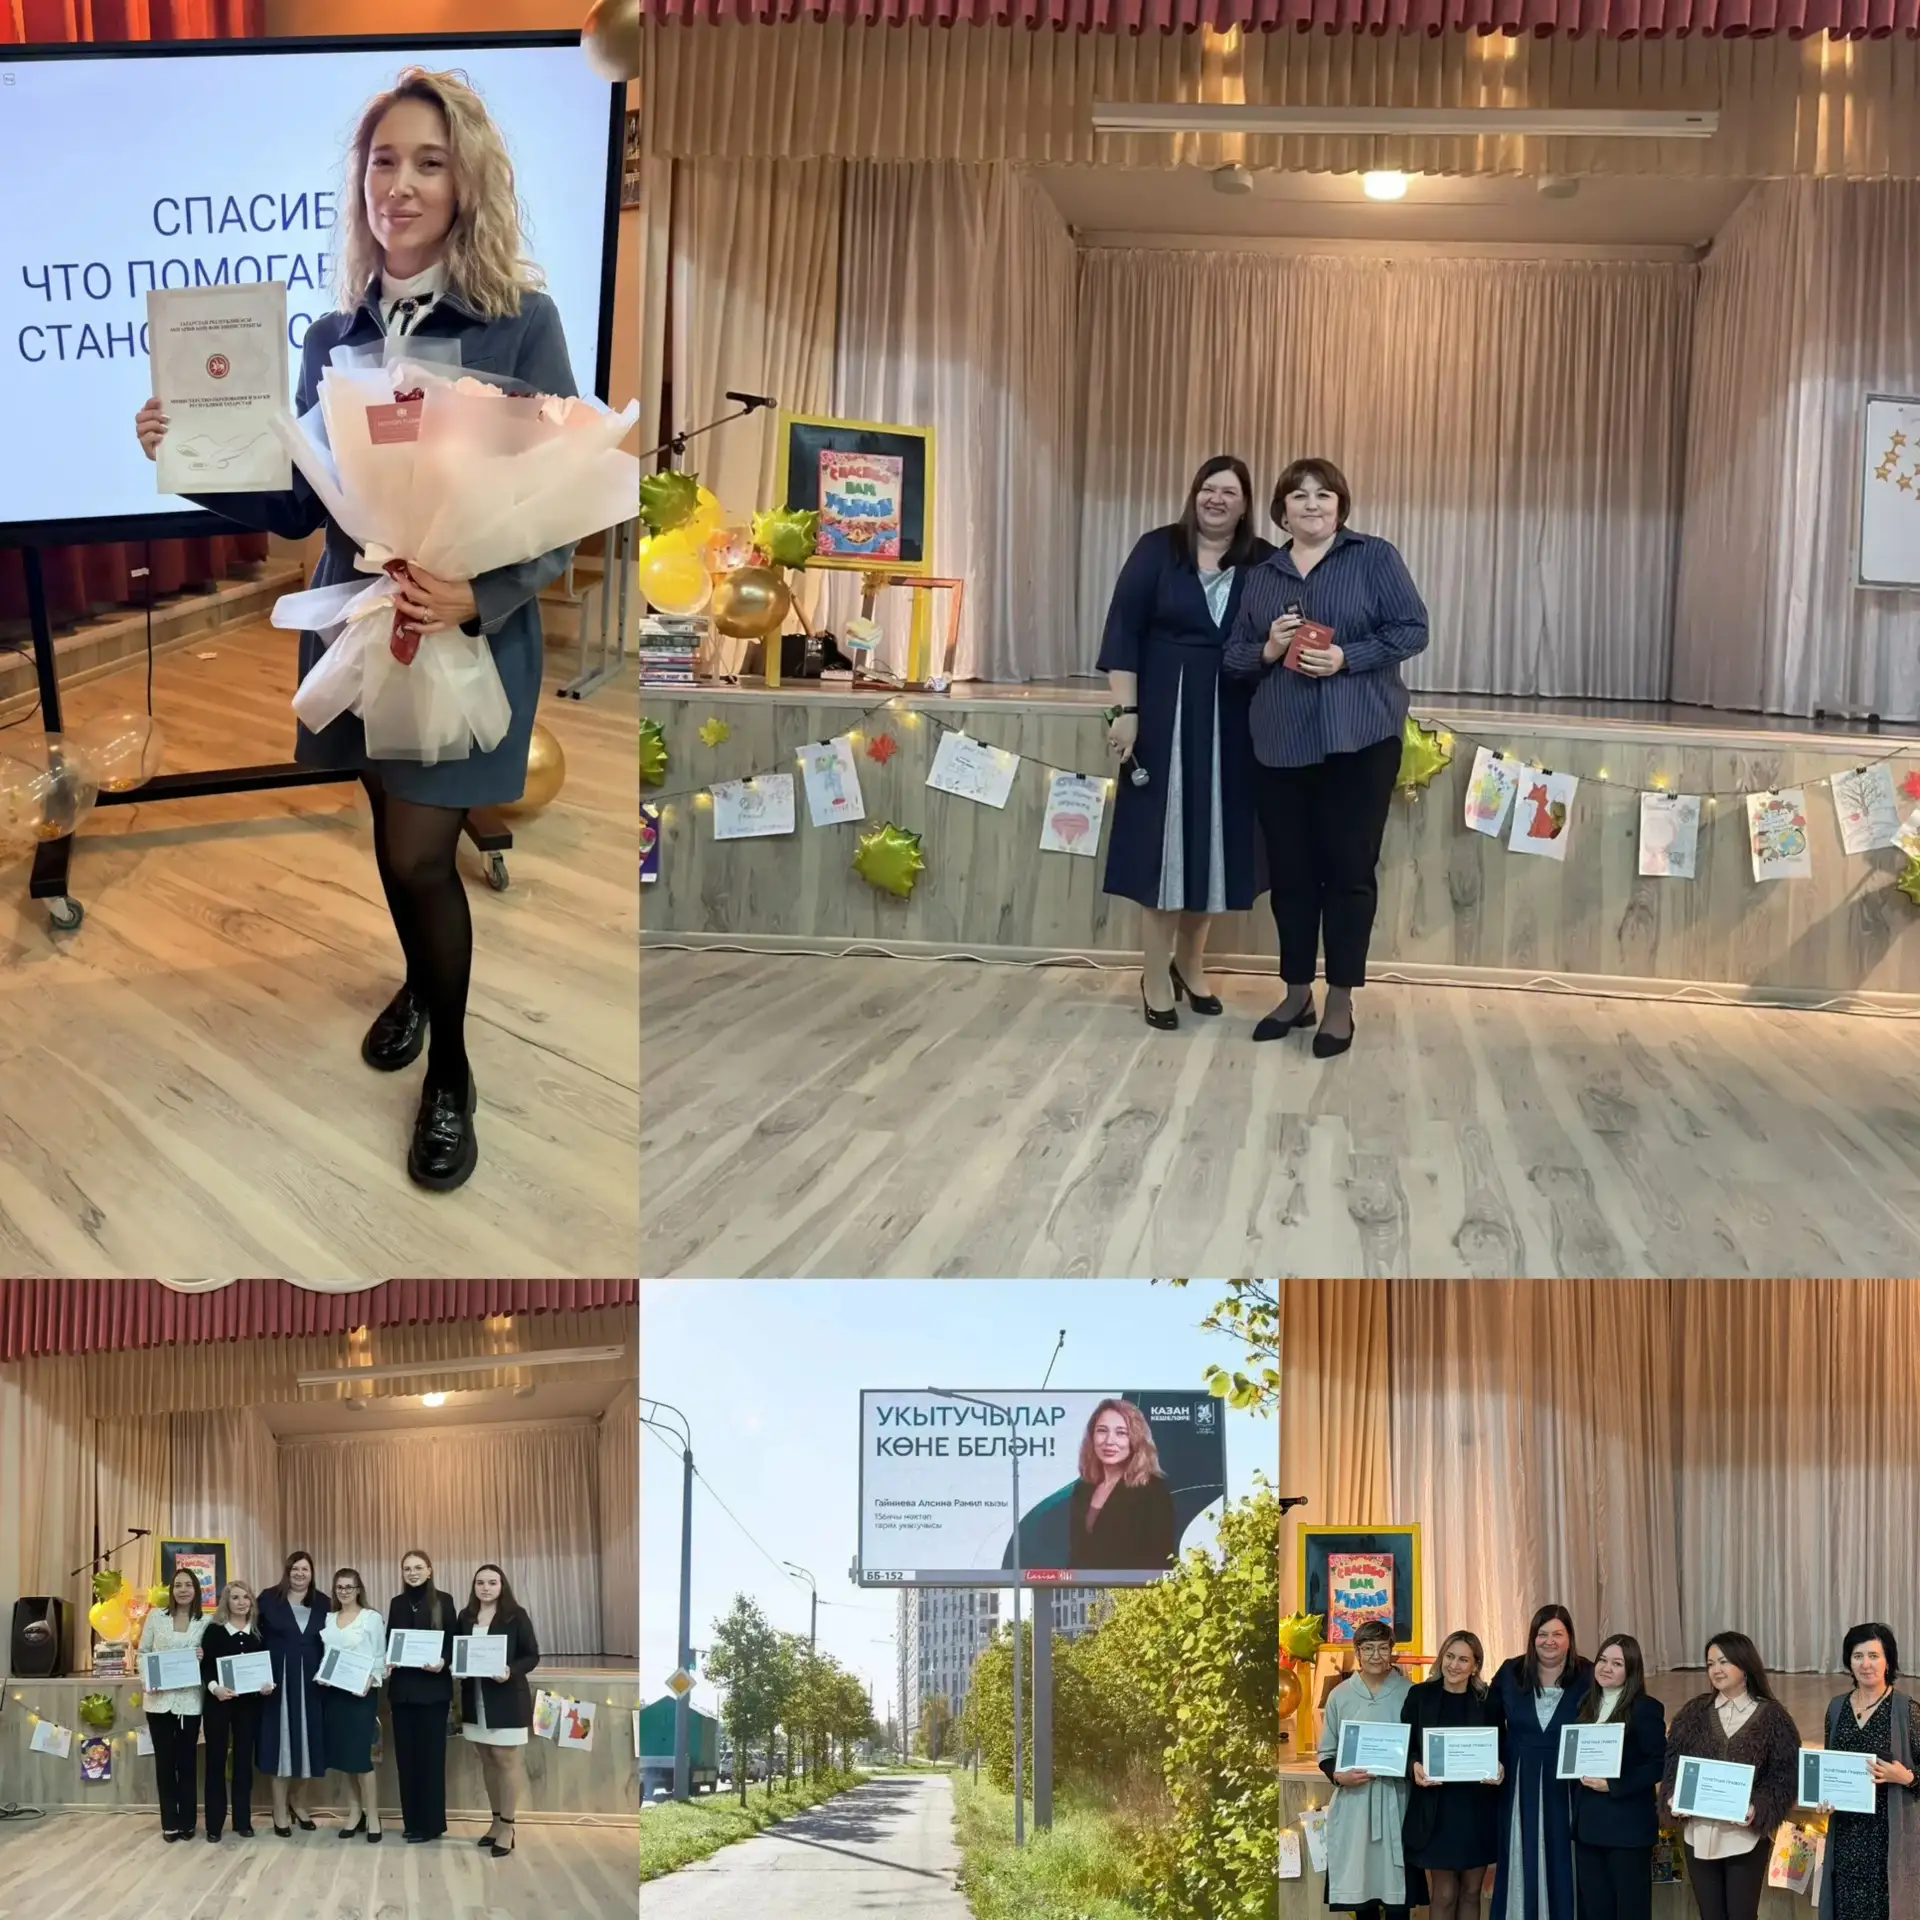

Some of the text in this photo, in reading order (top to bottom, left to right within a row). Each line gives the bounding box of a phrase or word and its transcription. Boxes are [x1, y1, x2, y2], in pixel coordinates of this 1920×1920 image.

[153, 192, 337, 236] СПАСИБ
[22, 252, 335, 302] ЧТО ПОМОГАЕ
[876, 1406, 1066, 1427] УКЫТУЧЫЛАР
[1150, 1406, 1189, 1415] КАЗАН
[876, 1436, 950, 1457] КӨНЕ
[875, 1498, 916, 1507] Гайниева
[954, 1499, 982, 1508] Рамил
[867, 1571, 904, 1580] ББ-152
